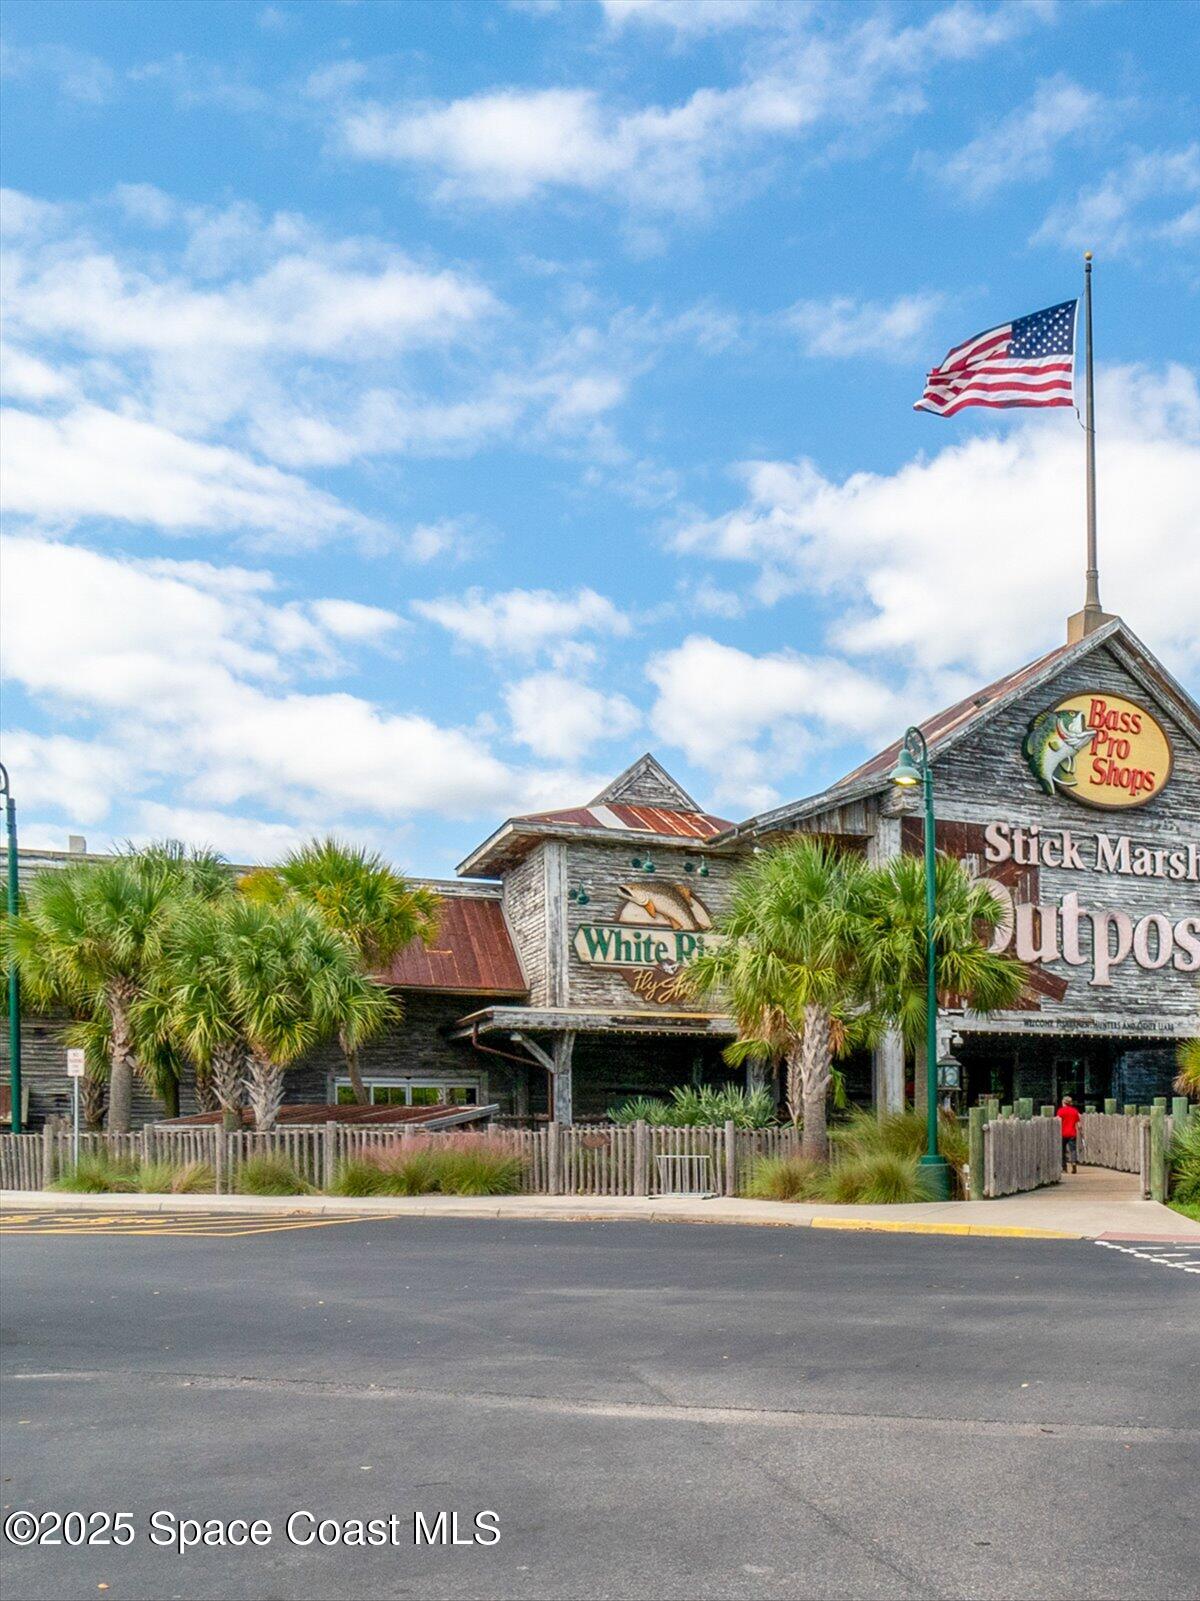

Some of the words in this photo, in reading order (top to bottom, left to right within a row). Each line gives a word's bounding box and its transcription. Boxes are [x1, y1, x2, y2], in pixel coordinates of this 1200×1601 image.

[1087, 699, 1141, 735] Bass
[1089, 729, 1131, 760] Pro
[1089, 757, 1156, 797] Shops
[985, 822, 1087, 870] Stick
[581, 927, 669, 963] White
[632, 969, 659, 1001] Fly
